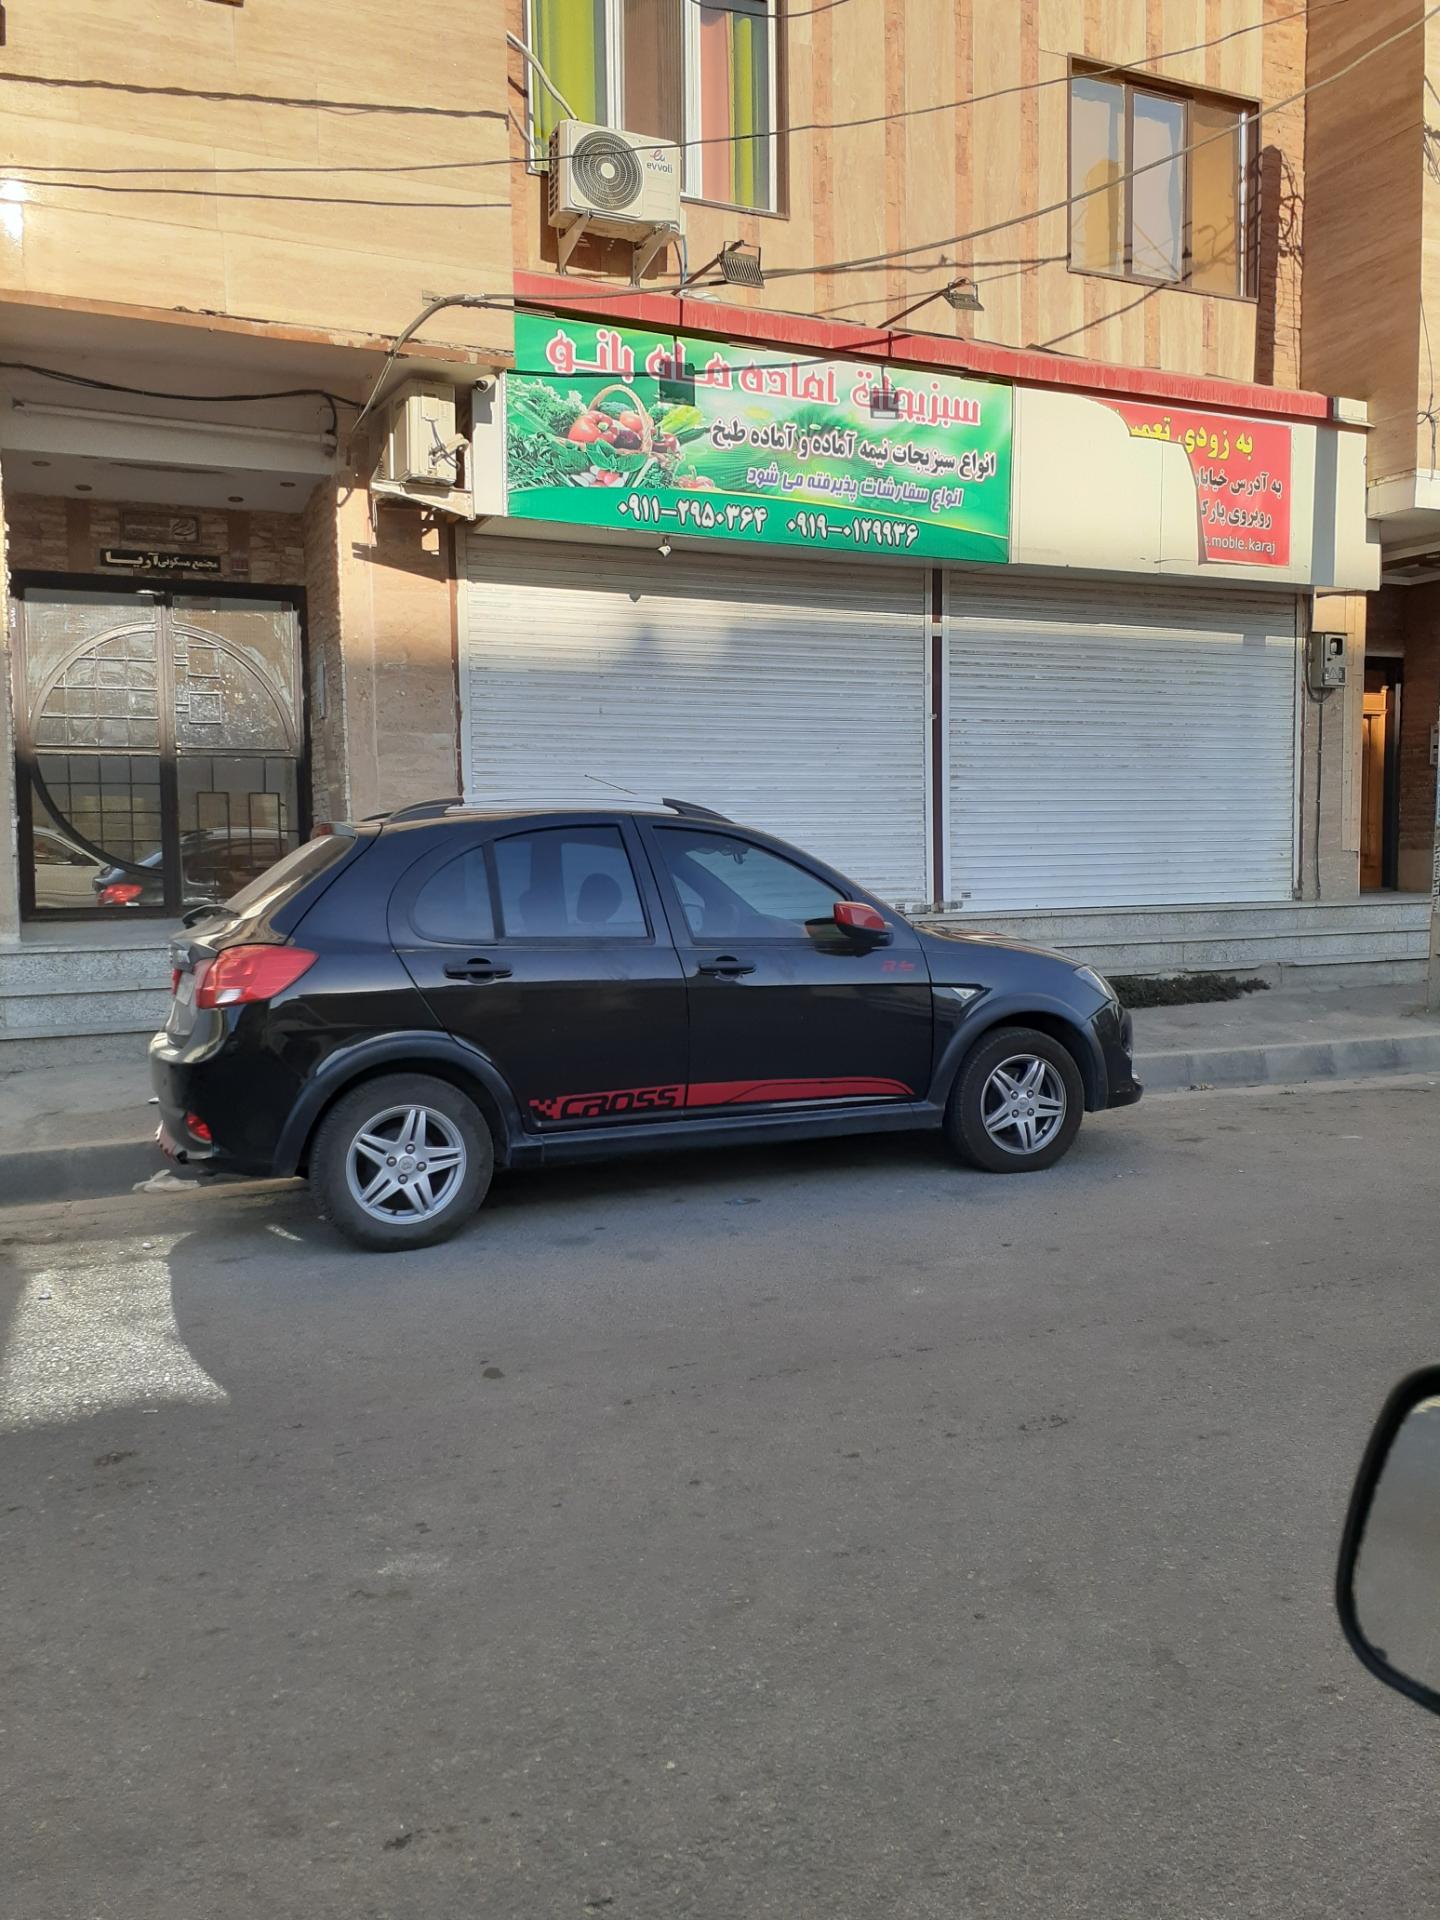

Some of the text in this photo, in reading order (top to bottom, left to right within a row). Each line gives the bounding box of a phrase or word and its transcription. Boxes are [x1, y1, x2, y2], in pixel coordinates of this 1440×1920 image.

[646, 162, 673, 174] evvoli
[547, 328, 634, 384] بانو
[741, 360, 839, 405] آماده
[711, 418, 996, 481] انواع سبزیجات نیمه آماده و آماده طبخ
[1177, 425, 1230, 461] زودی
[1236, 431, 1253, 461] به
[747, 461, 963, 512] انواع سفارشات پذیرفته می شود
[1230, 472, 1269, 496] آدرس
[1270, 479, 1282, 499] به
[1228, 507, 1271, 529] روبروی
[105, 551, 160, 569] آریا
[561, 1088, 680, 1119] CROSS
